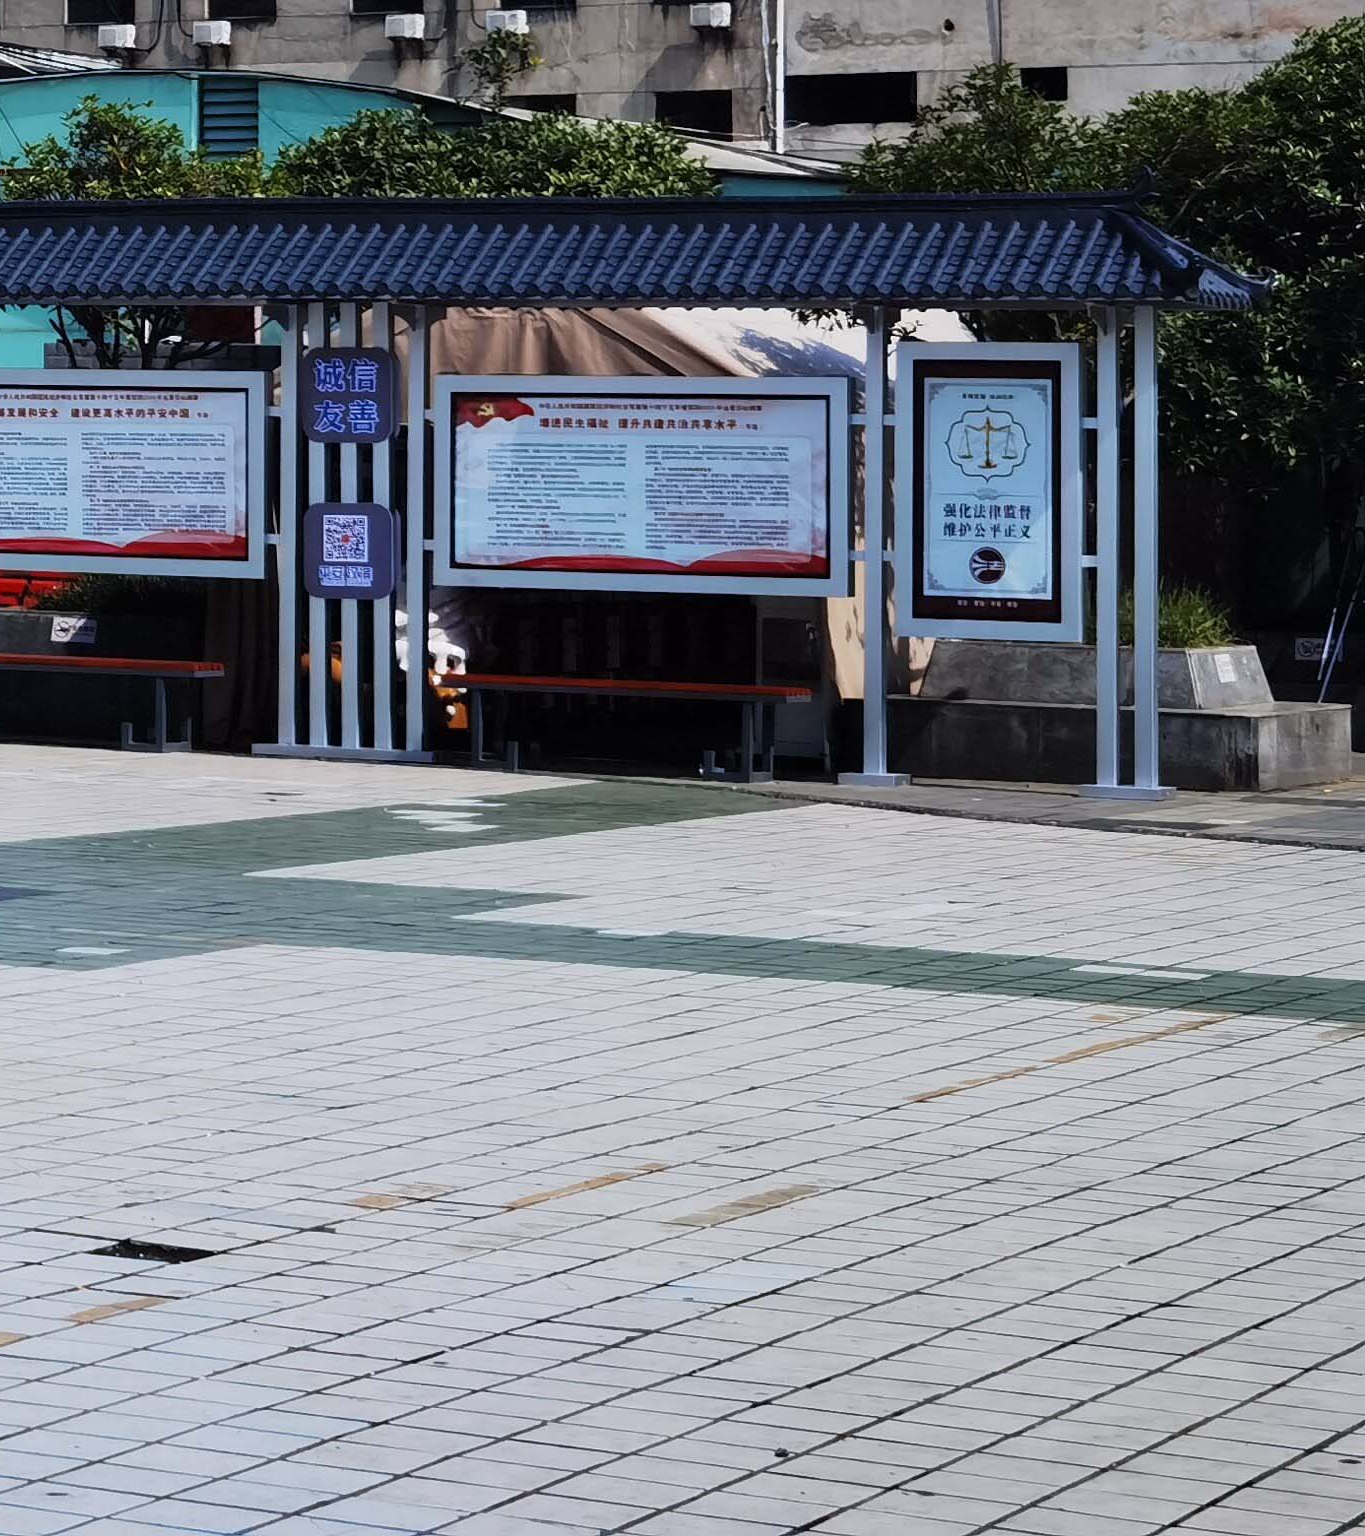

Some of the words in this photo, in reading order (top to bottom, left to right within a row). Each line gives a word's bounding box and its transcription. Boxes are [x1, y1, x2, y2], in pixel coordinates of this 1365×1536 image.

[314, 358, 380, 393] 诚信
[70, 407, 190, 421] 建设更高水平的平安中国
[313, 399, 380, 434] 友善
[942, 502, 1033, 520] 强化法律监督
[942, 522, 1032, 540] 维护公平正义
